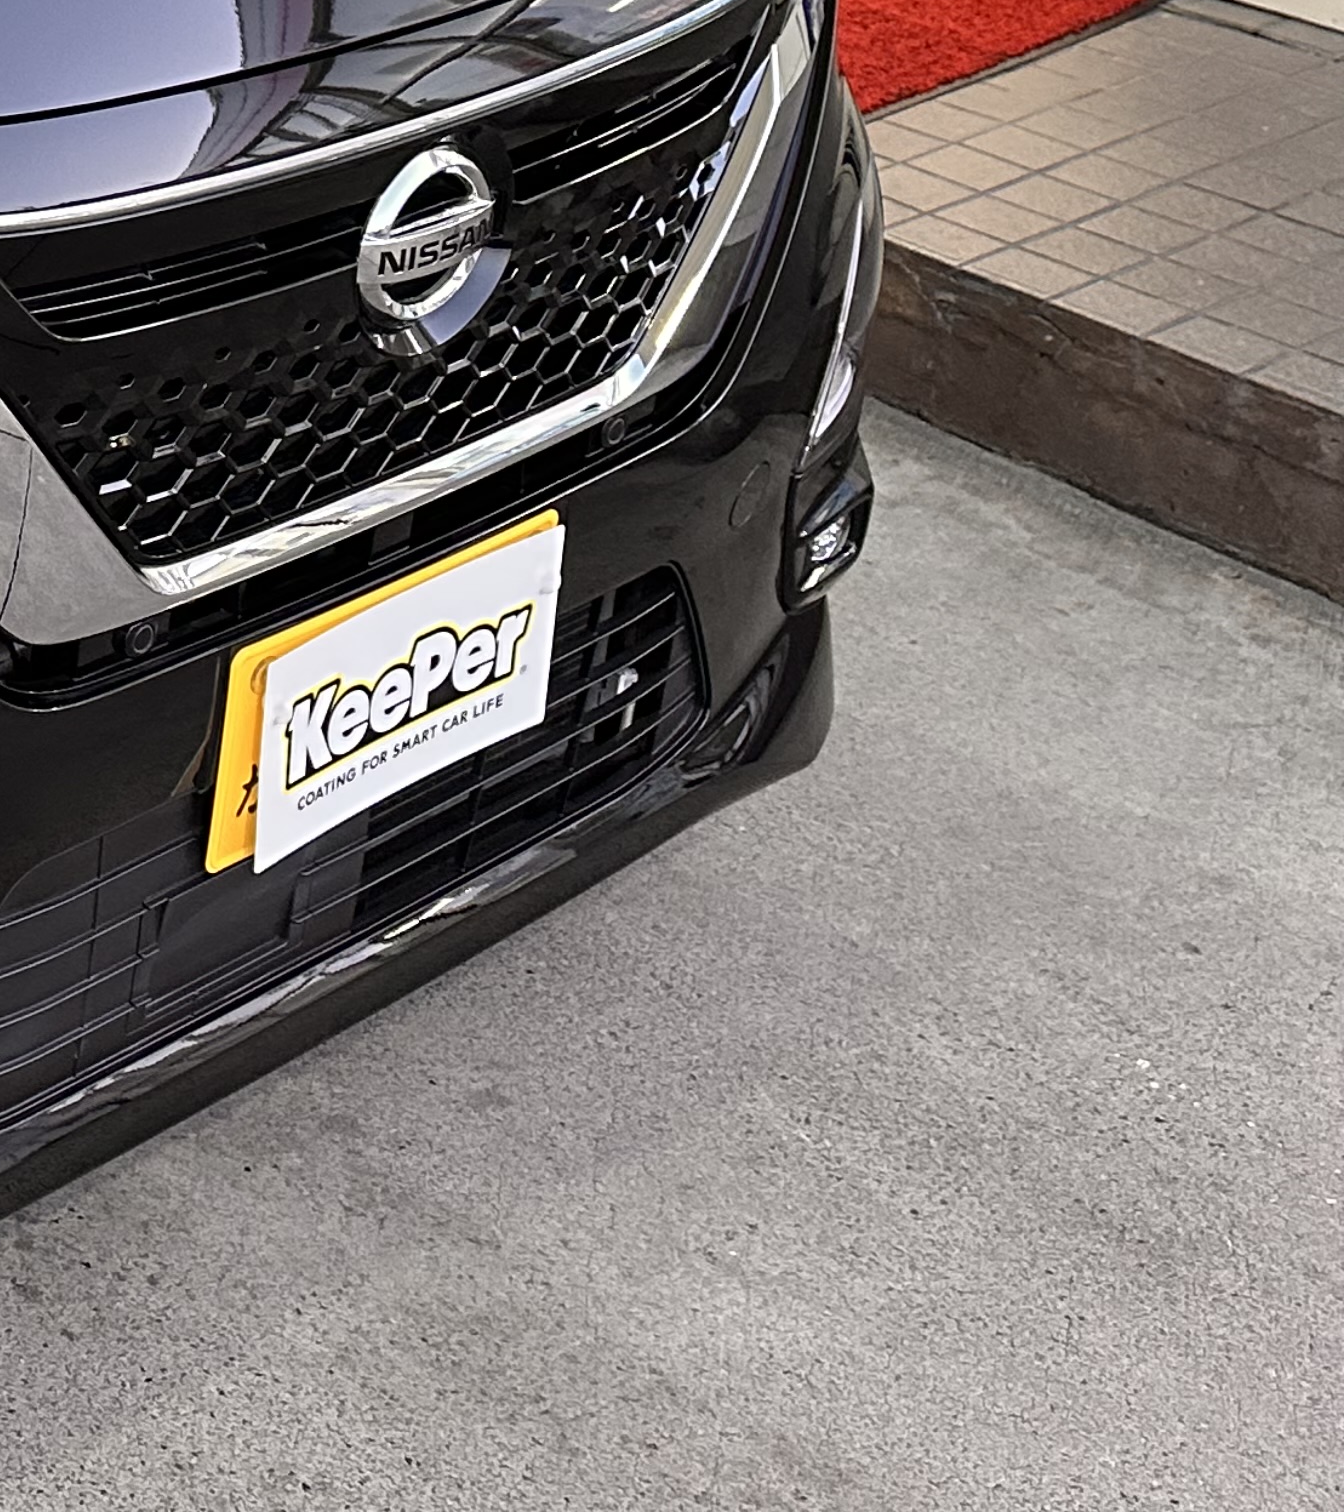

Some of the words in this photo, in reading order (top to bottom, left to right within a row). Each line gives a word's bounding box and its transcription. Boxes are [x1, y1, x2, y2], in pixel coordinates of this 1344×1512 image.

[378, 218, 492, 276] NISSAN
[285, 604, 533, 790] KeePer
[297, 768, 356, 811] COATING
[362, 751, 388, 776] FOR
[392, 725, 437, 759] SMART
[442, 710, 468, 733] CAR
[472, 693, 505, 719] LIFE
